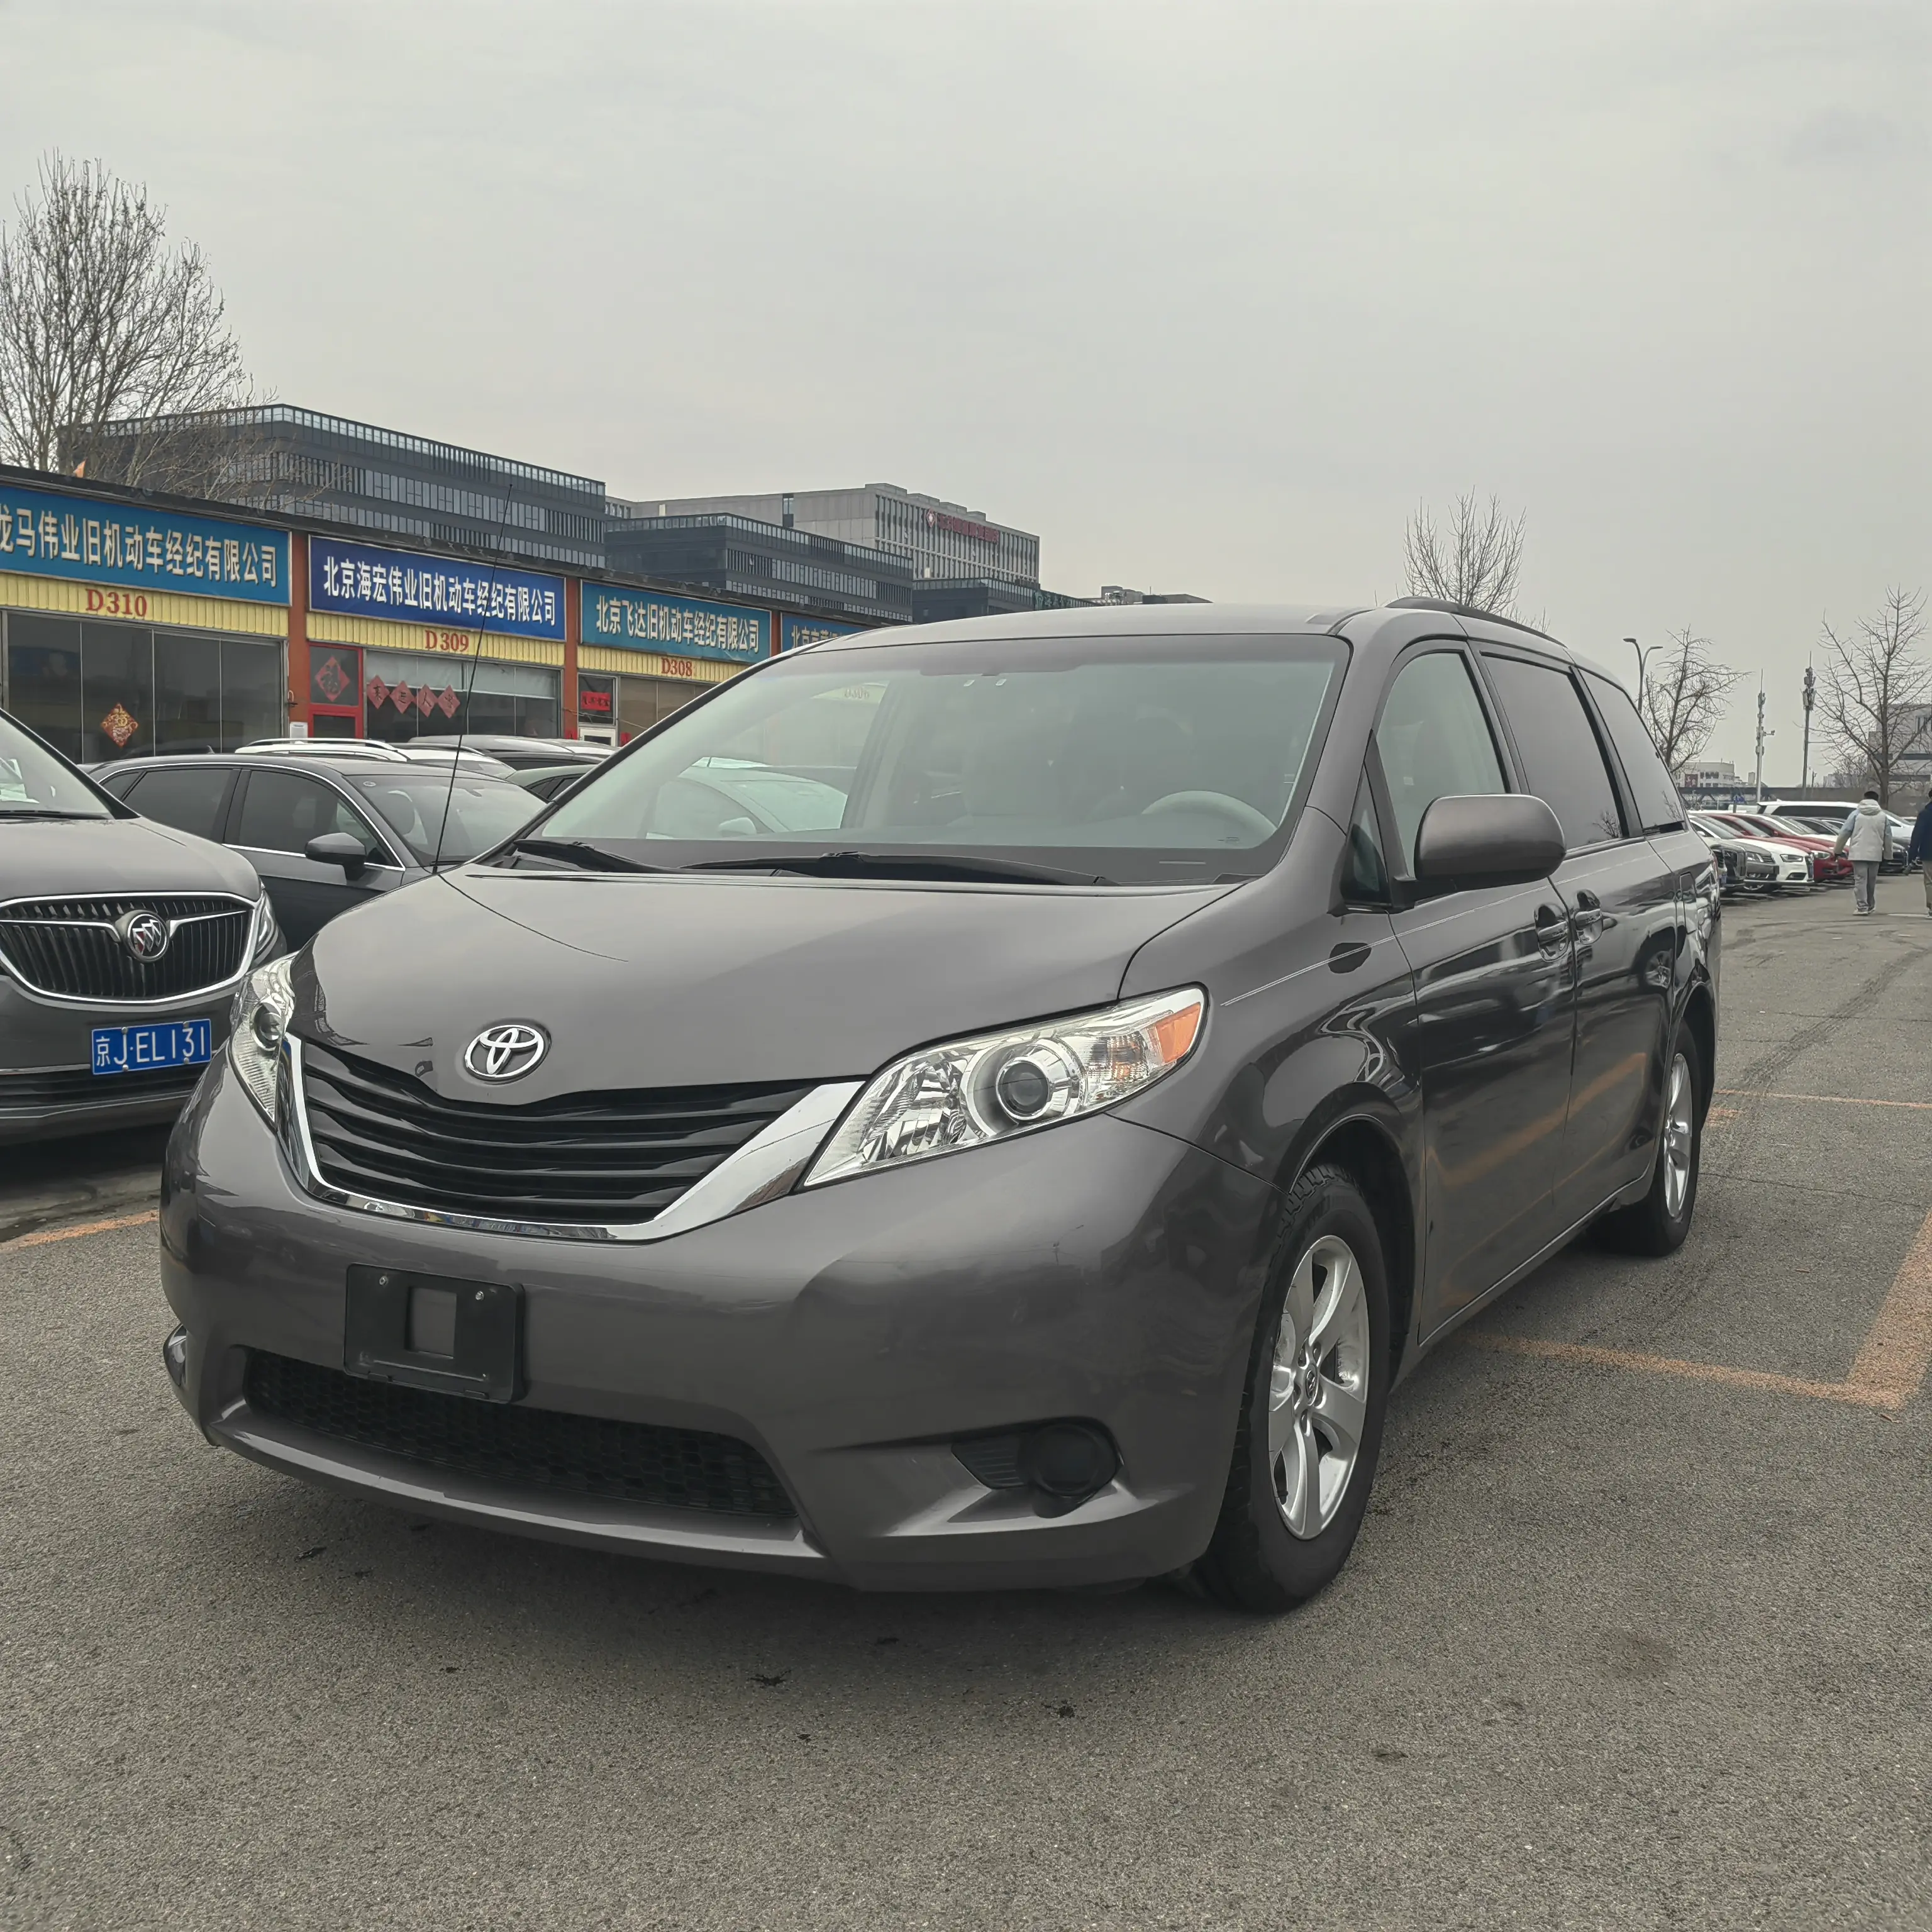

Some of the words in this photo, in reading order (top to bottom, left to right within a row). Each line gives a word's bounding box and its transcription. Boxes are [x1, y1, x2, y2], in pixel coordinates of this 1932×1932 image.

[0, 503, 277, 588] 龙马伟业旧机动车经纪有限公司
[85, 589, 147, 617] D310
[323, 556, 556, 626] 北京海宏伟业旧机动车经纪有限公司
[425, 630, 469, 652] D309
[596, 595, 759, 653] 北京飞达旧机动车经纪有限公司
[661, 657, 692, 677] D308
